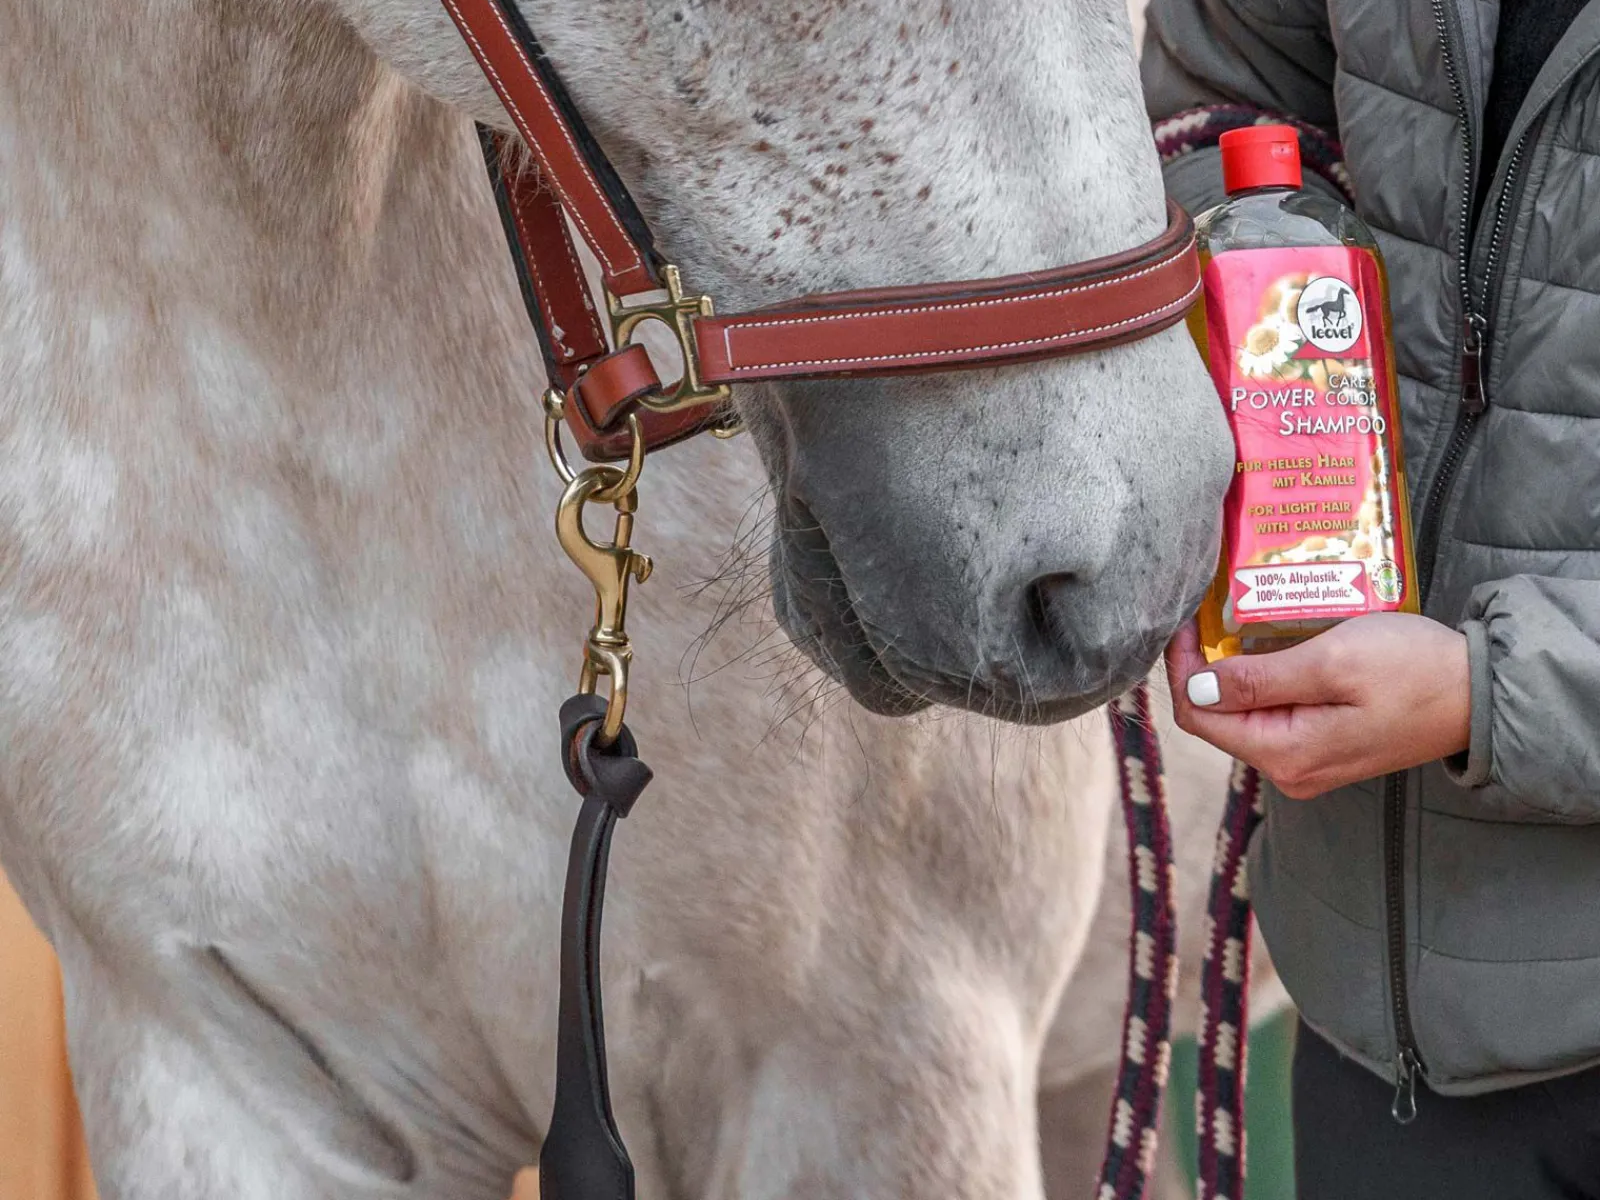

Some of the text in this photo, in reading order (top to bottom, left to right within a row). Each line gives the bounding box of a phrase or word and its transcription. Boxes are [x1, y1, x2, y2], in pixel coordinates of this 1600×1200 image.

[1329, 374, 1366, 388] CARE
[1231, 387, 1377, 411] POWER COLOR
[1279, 410, 1386, 436] SHAMPOO
[1268, 457, 1313, 471] HELLES
[1317, 453, 1356, 468] HAAR
[1272, 471, 1356, 488] MIT KAMILLE
[1248, 500, 1351, 517] FOR LIGHT HAIR
[1255, 520, 1289, 534] WITH
[1254, 573, 1287, 587] 100%
[1256, 589, 1283, 603] 100%
[1285, 586, 1320, 602] recycled
